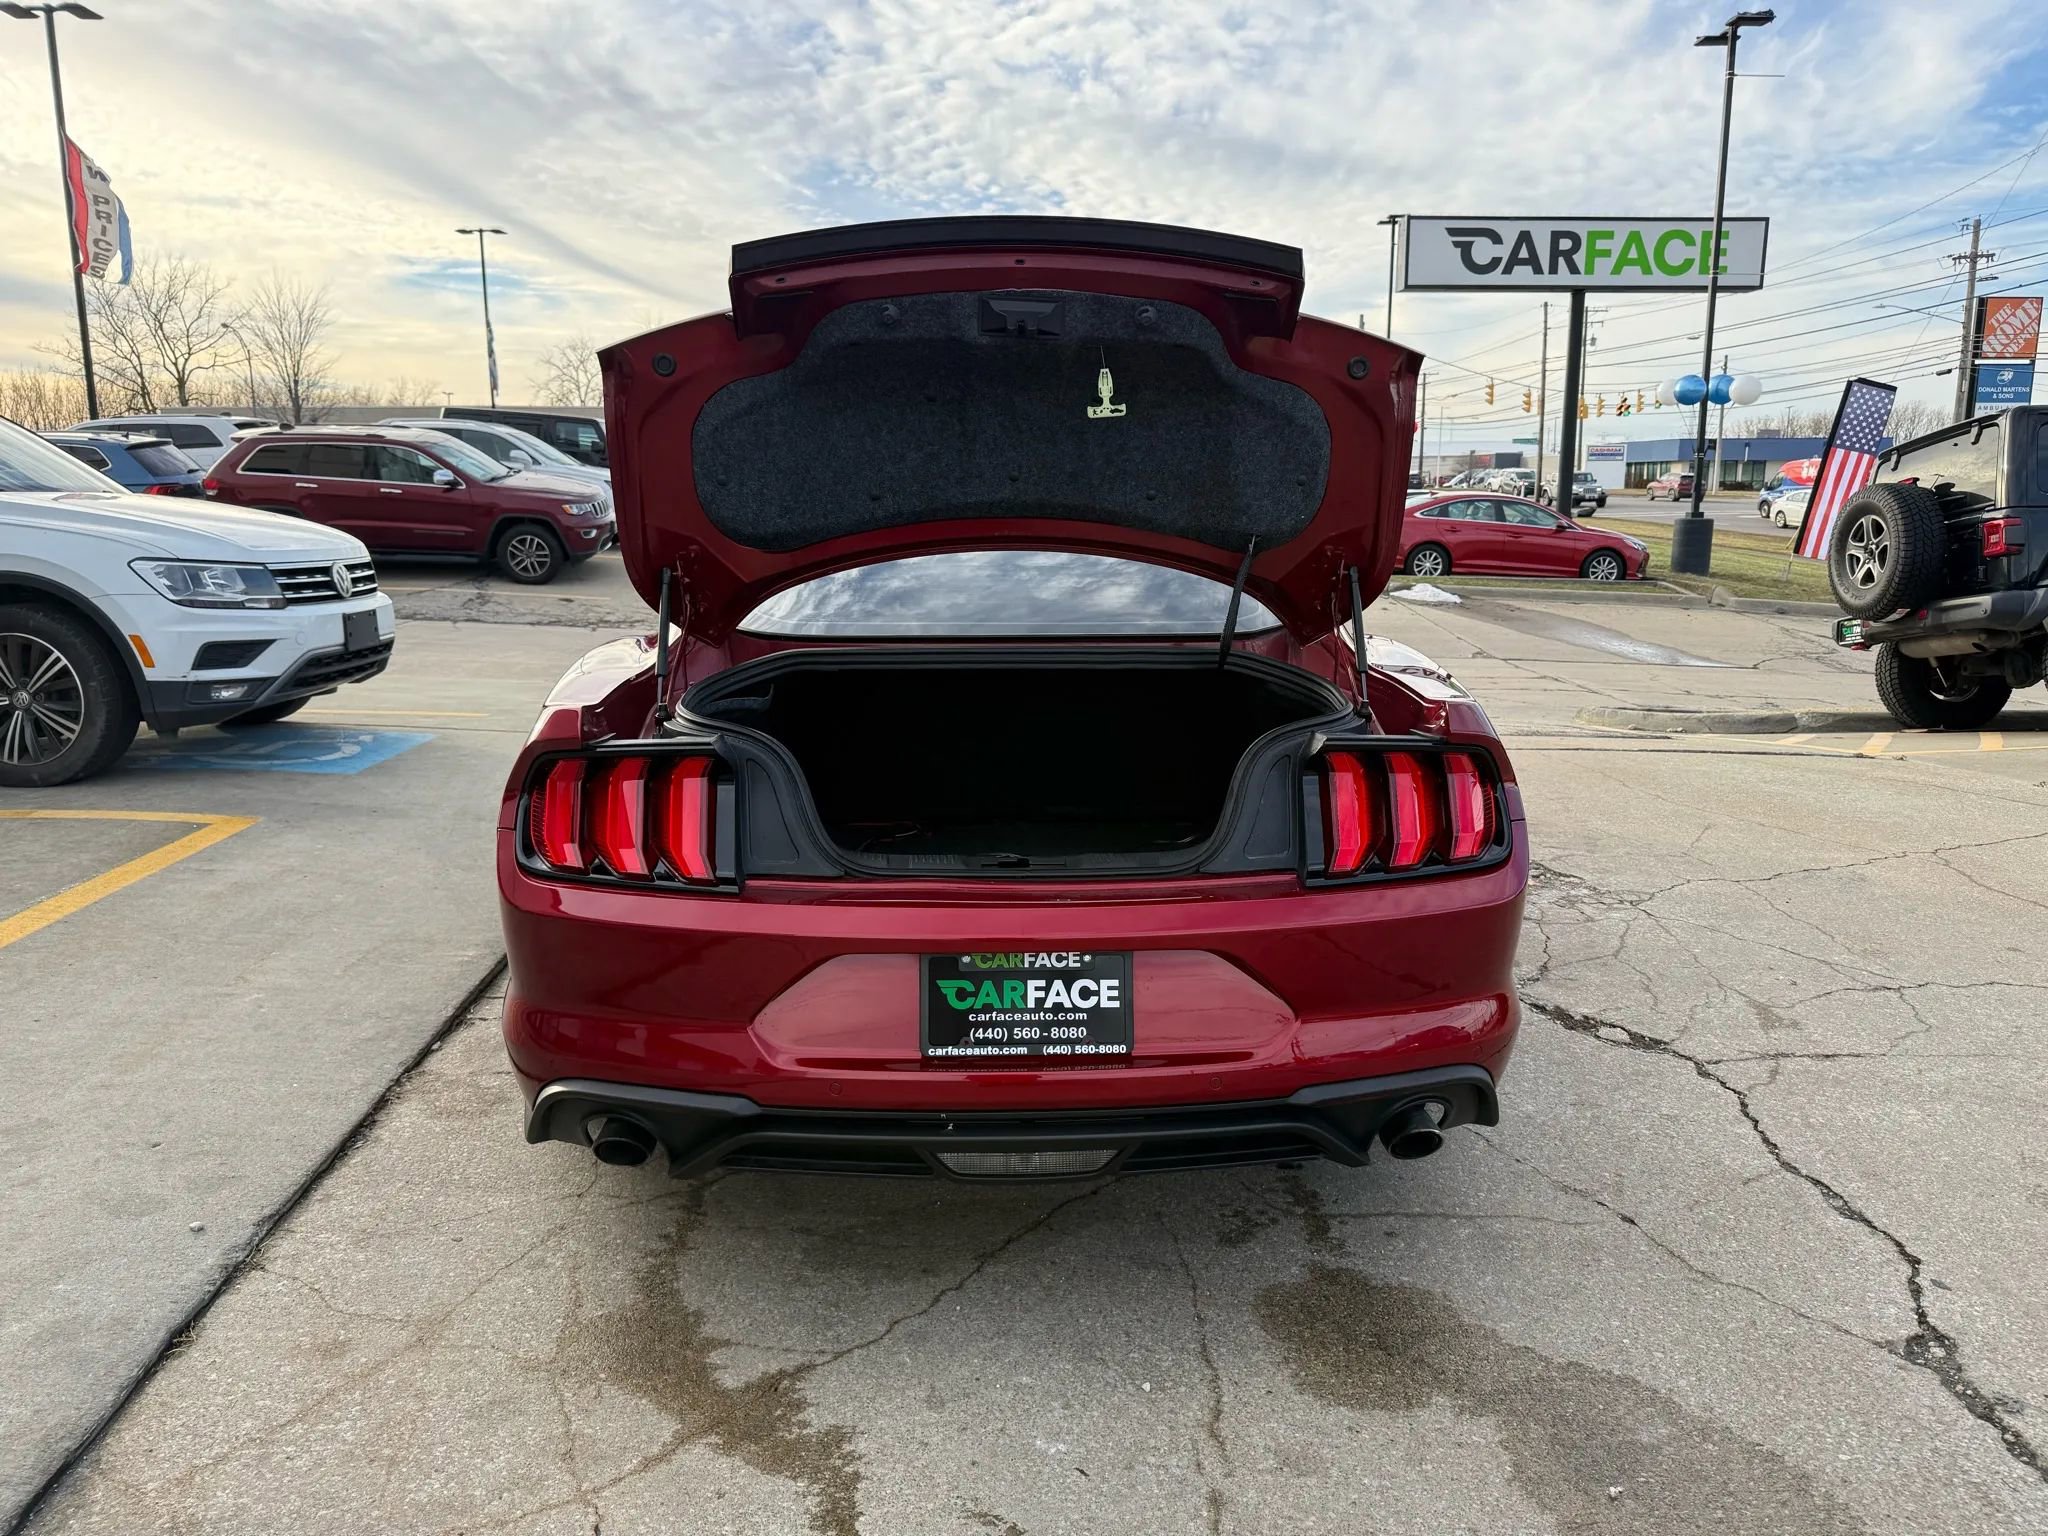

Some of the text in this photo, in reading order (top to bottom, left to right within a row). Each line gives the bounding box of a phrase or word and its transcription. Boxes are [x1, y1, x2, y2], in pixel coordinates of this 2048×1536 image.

[1445, 227, 1730, 277] CARFACE
[972, 952, 1081, 969] CARFACE
[936, 978, 1120, 1010] CARFACE
[968, 1011, 1088, 1021] carfaceauto.com
[969, 1027, 1008, 1042] (440)
[928, 1045, 1127, 1056] carfaceauto.com (440) 560-8080
